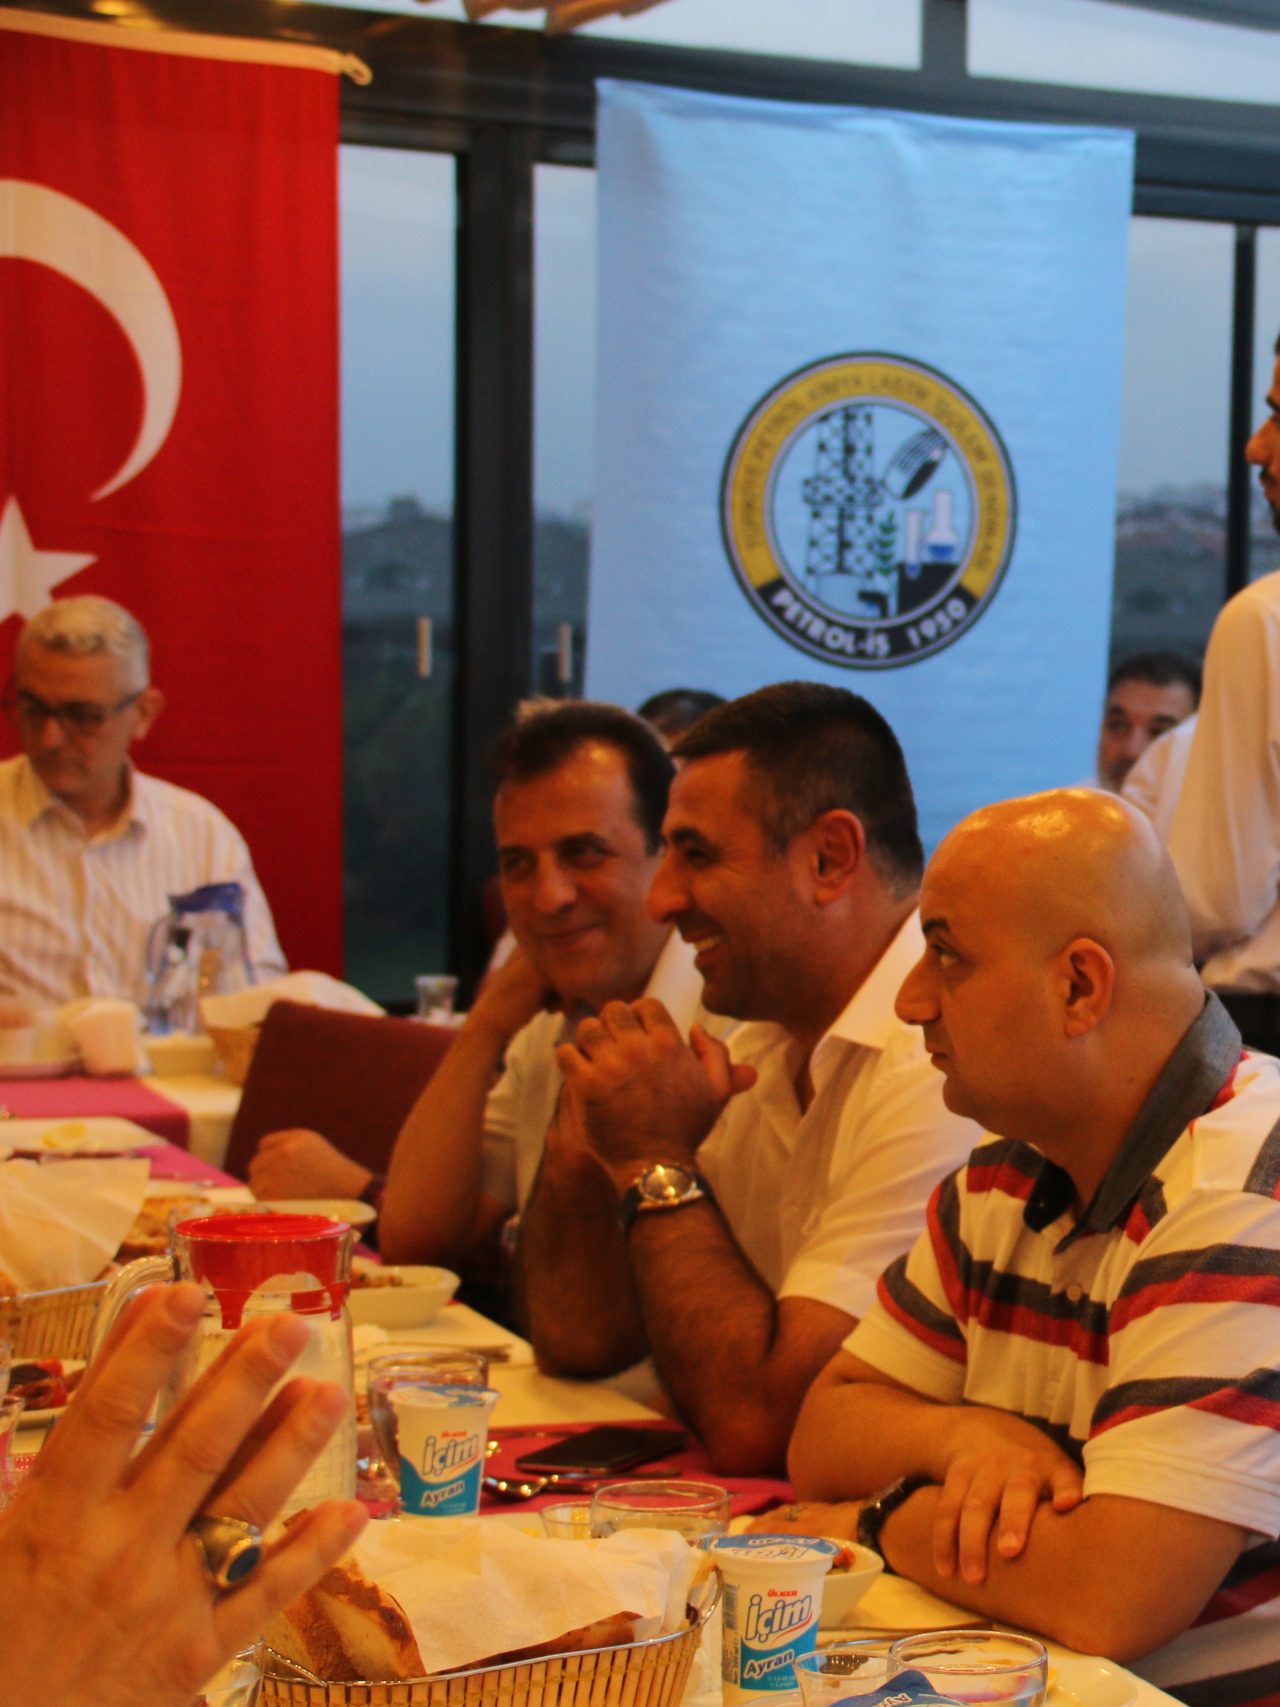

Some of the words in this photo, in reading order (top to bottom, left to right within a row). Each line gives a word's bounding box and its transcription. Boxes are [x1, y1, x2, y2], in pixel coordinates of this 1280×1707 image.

[907, 598, 968, 648] 1950
[421, 1480, 465, 1508] Ayran
[743, 1649, 795, 1679] Ayran
